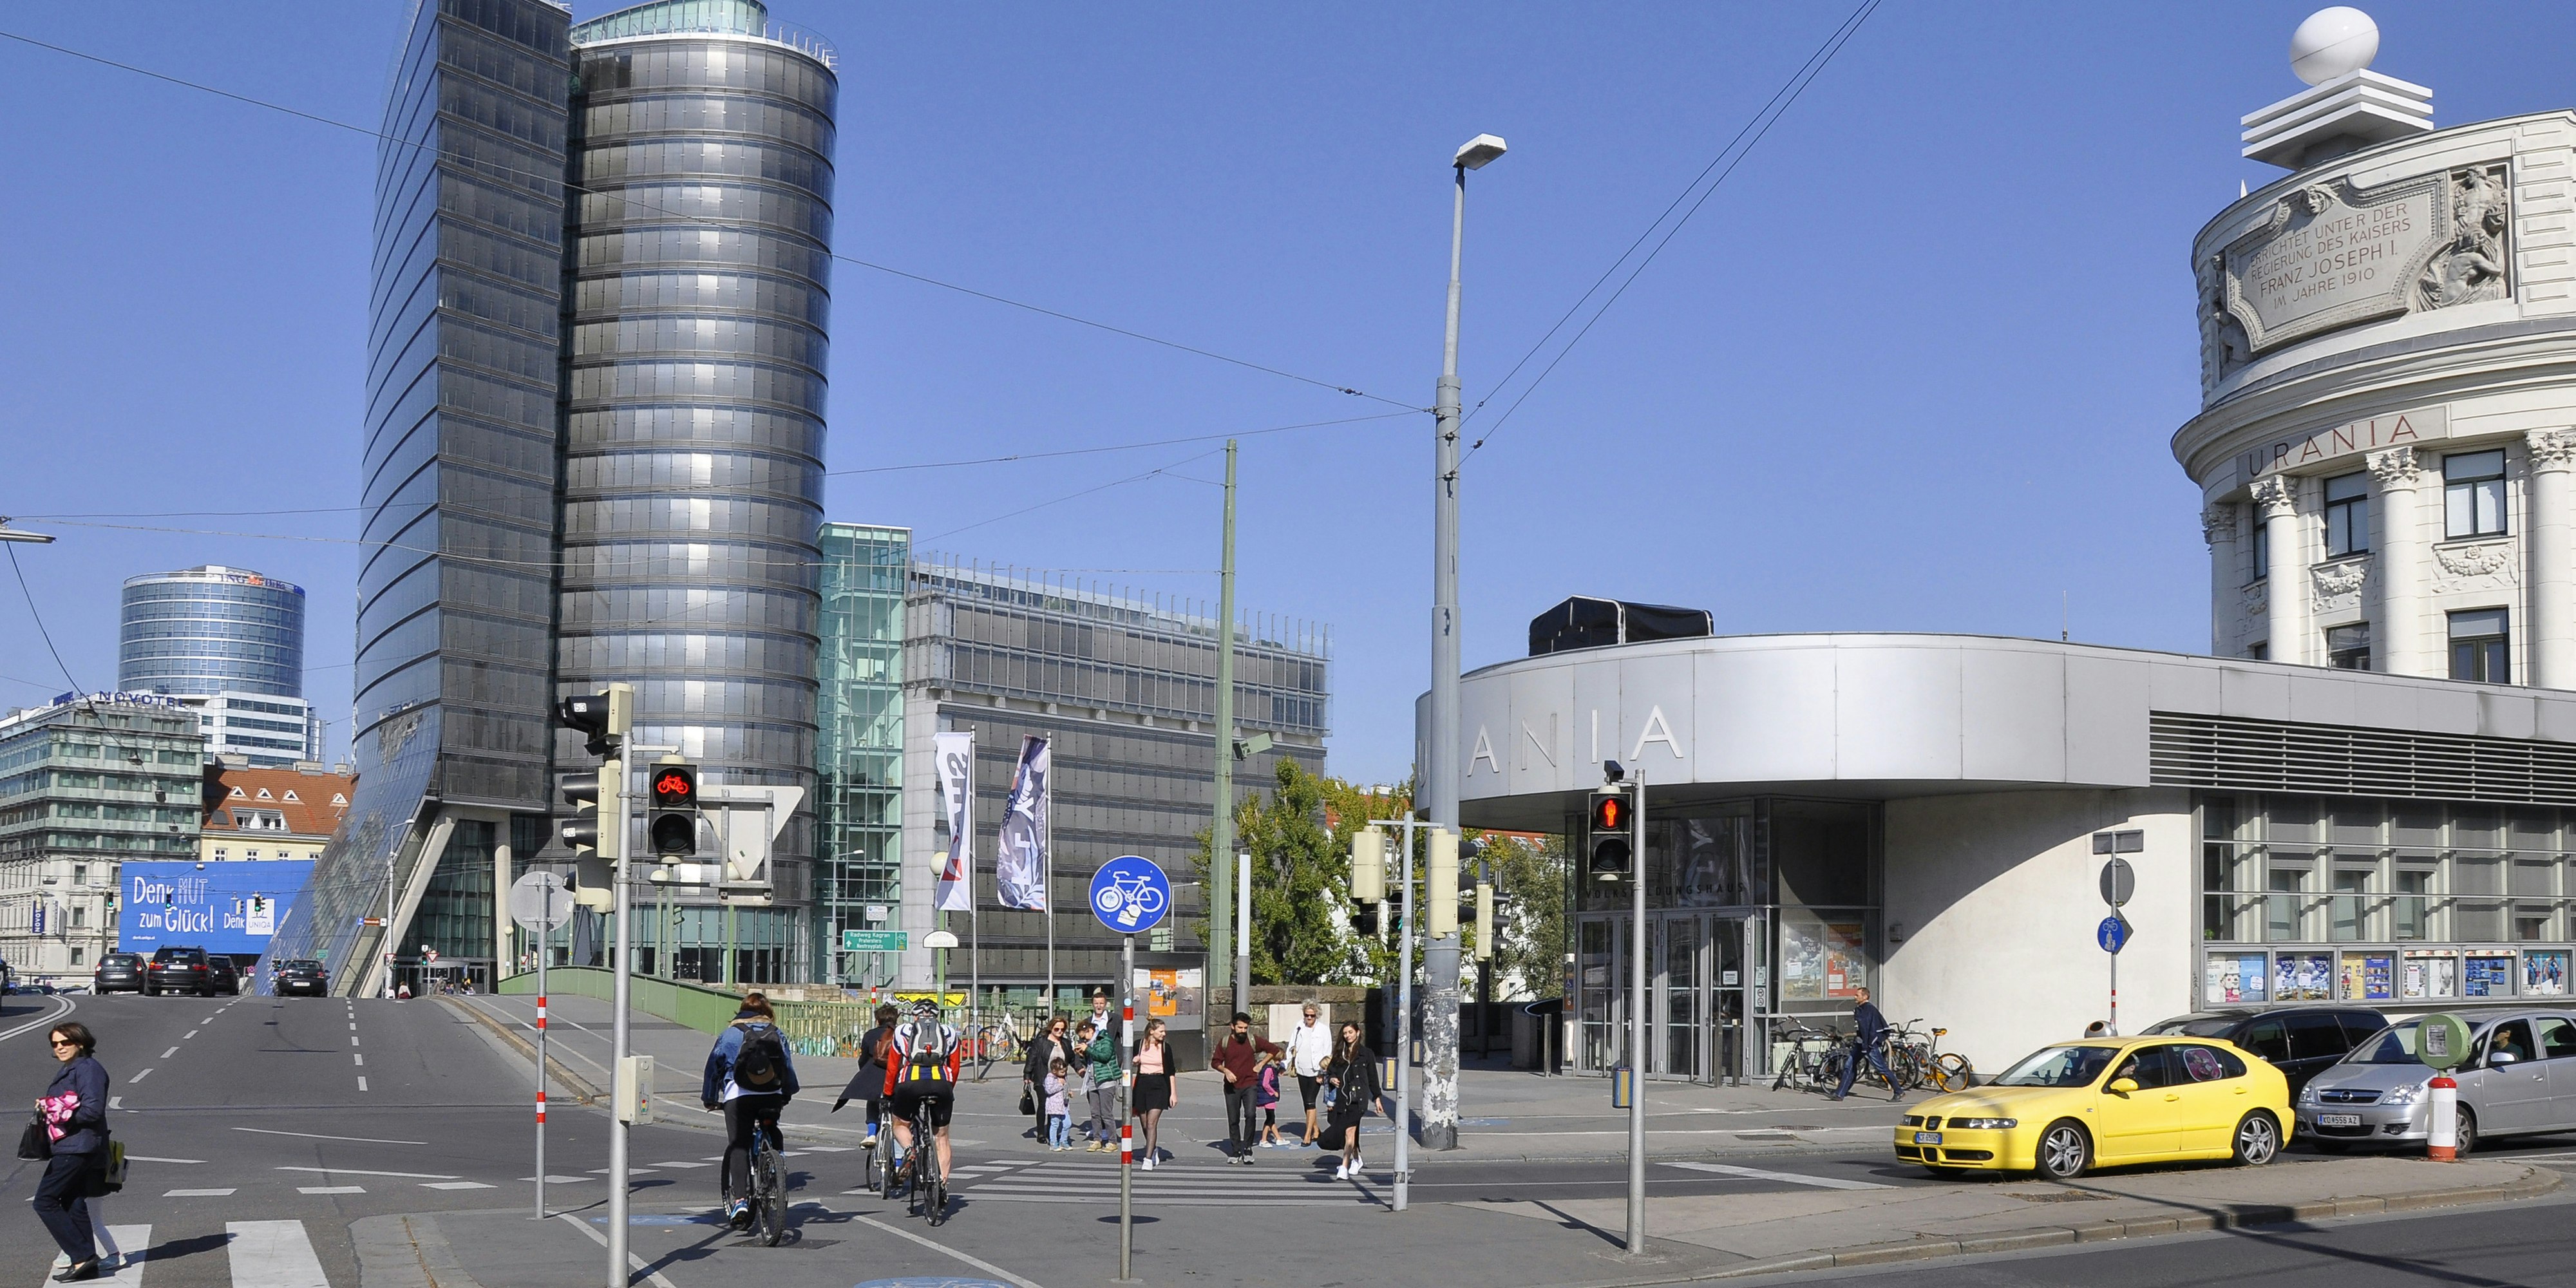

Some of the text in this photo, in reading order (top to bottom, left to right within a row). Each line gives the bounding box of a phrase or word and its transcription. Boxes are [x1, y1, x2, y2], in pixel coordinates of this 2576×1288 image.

[2250, 203, 2407, 267] ERRICHTET UNTER DER
[2251, 218, 2410, 282] REGIERUNG DES KAISERS
[2260, 267, 2302, 298] FRANZ
[2309, 243, 2382, 278] JOSEPH
[2274, 268, 2374, 309] IM JAHRE 1910
[2249, 415, 2419, 477] URANIA
[220, 574, 245, 584] ING
[99, 690, 186, 708] NOVOTEL
[1418, 705, 1685, 788] UANIA
[178, 877, 208, 905] MUT
[1587, 882, 1743, 899] VOLKSLDUNGSHAUS
[139, 905, 214, 933] zum Glück!
